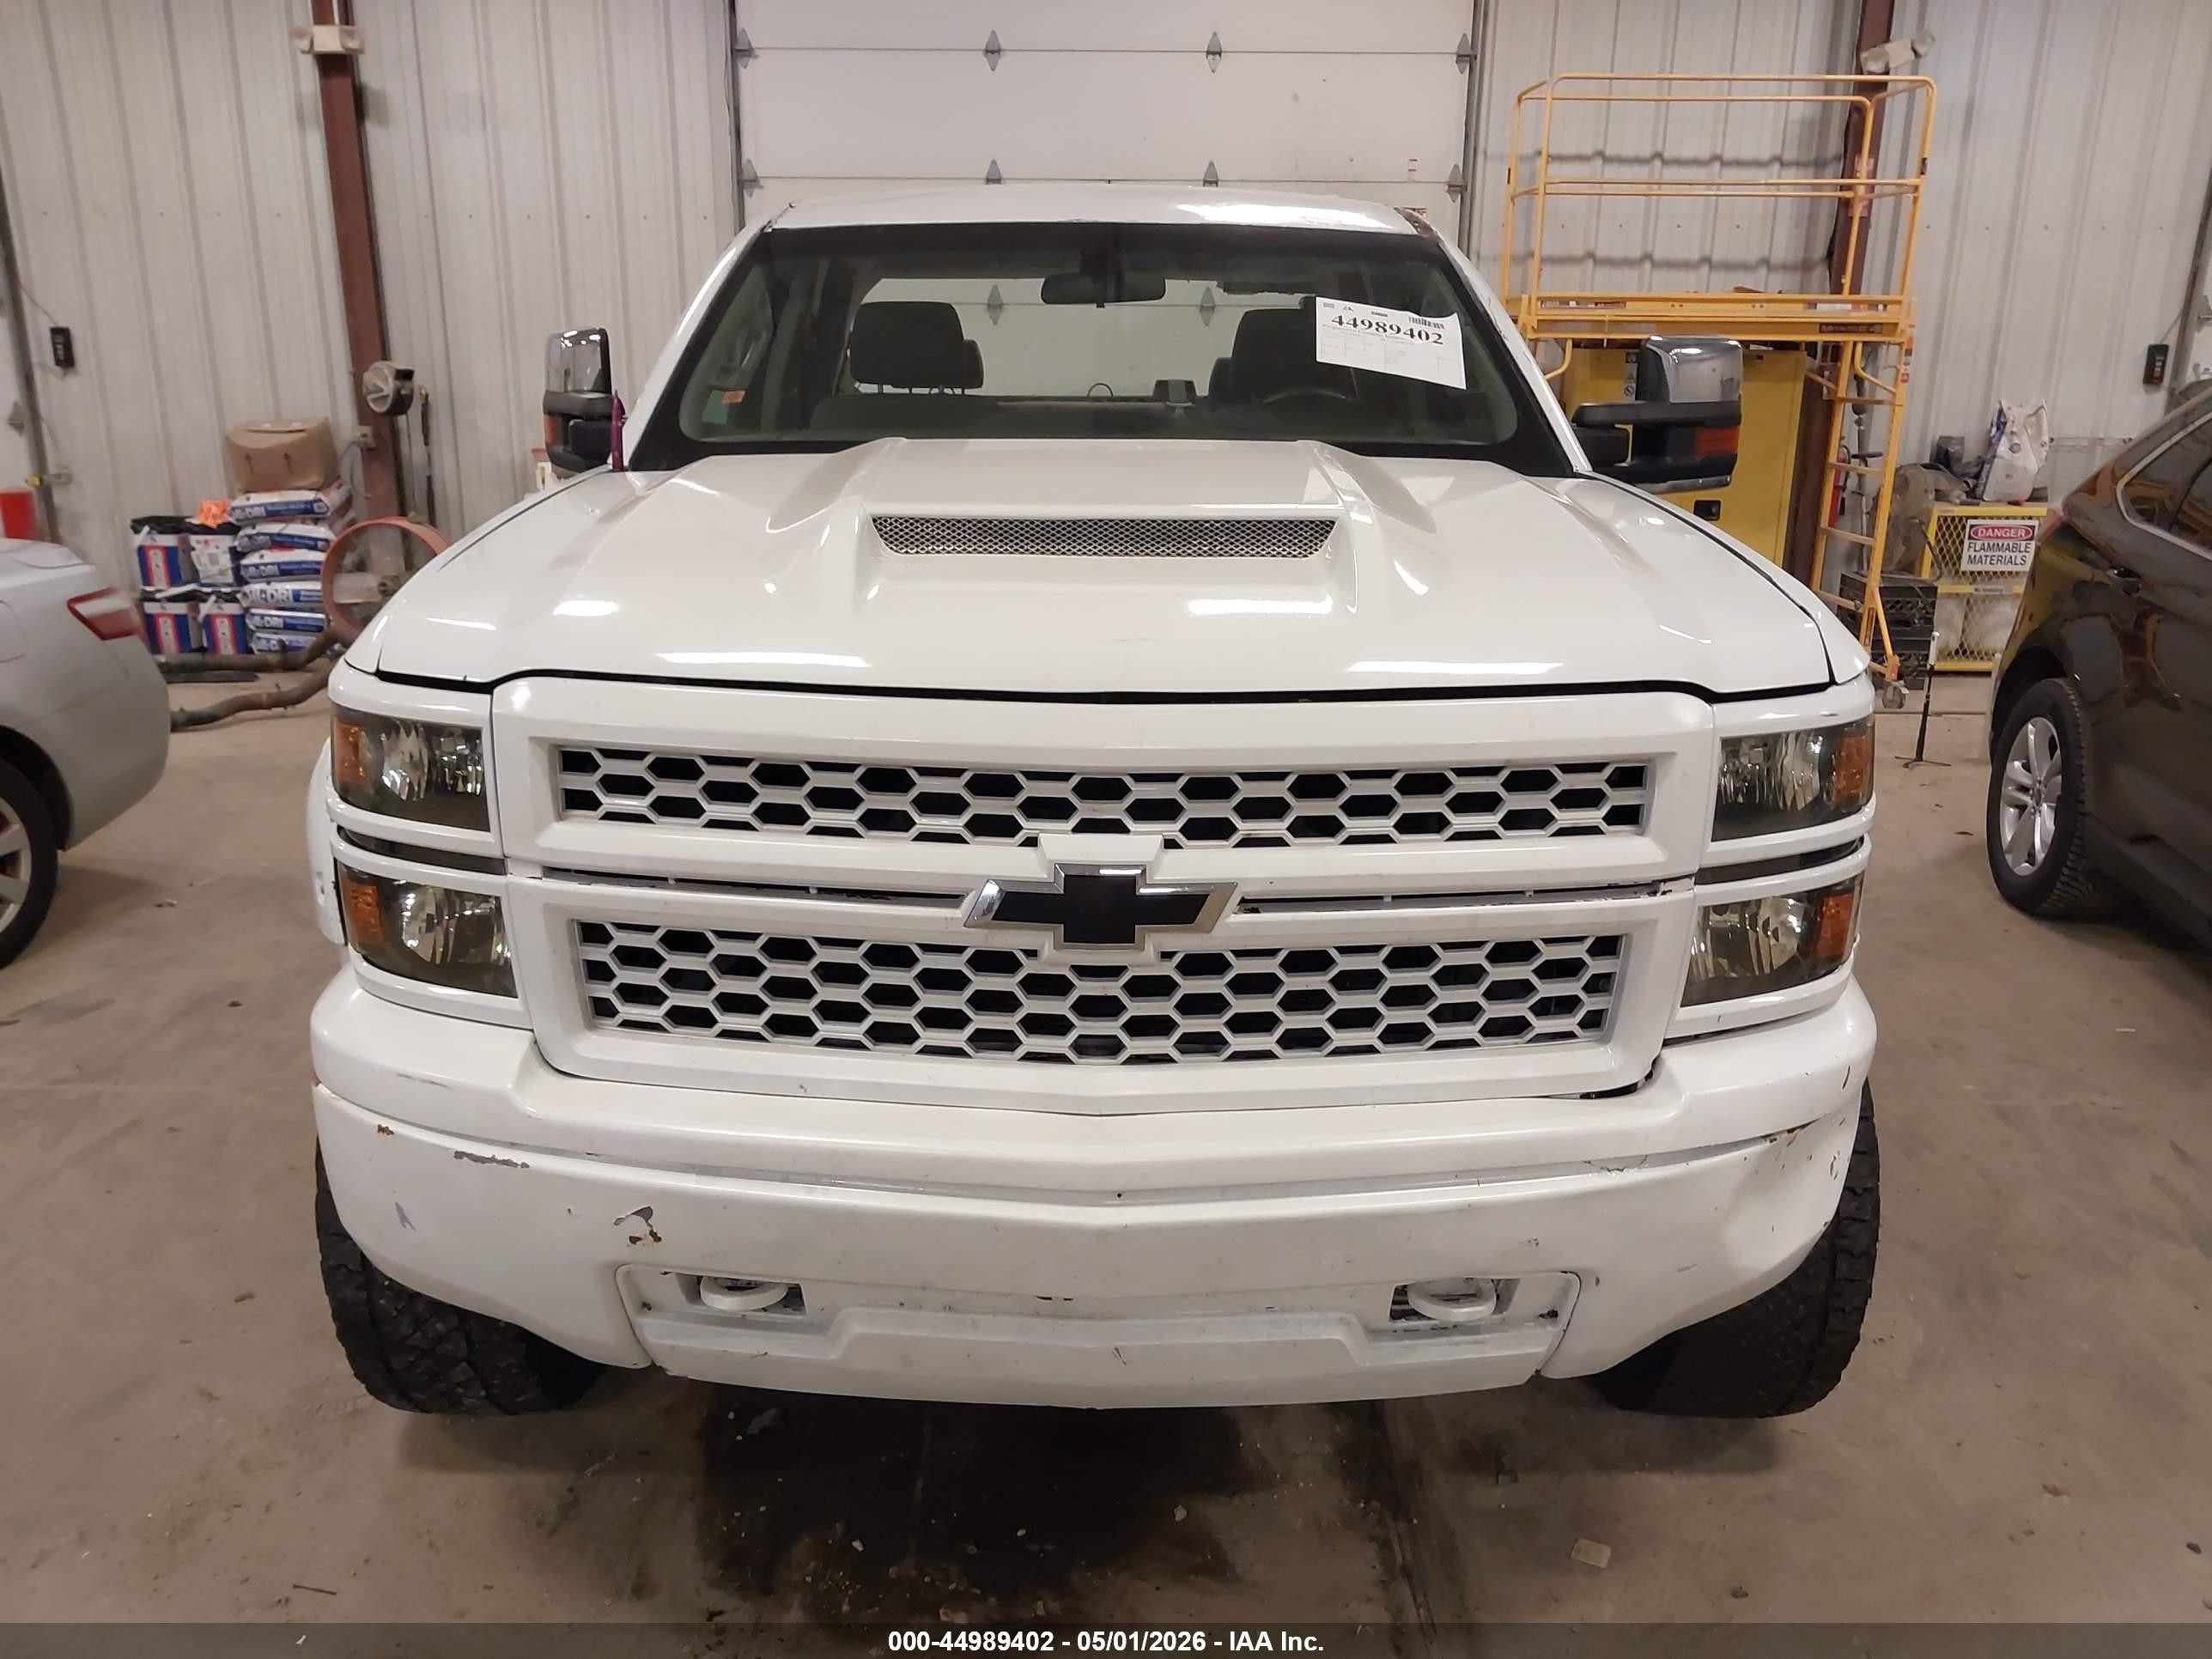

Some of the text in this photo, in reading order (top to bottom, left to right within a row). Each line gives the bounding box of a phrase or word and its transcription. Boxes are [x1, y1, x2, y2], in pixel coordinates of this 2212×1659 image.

[1331, 314, 1443, 345] 44989402
[1978, 528, 2026, 538] DANGER
[1967, 542, 2032, 554] FLAMMABLE
[1966, 555, 2027, 567] MATERIALS
